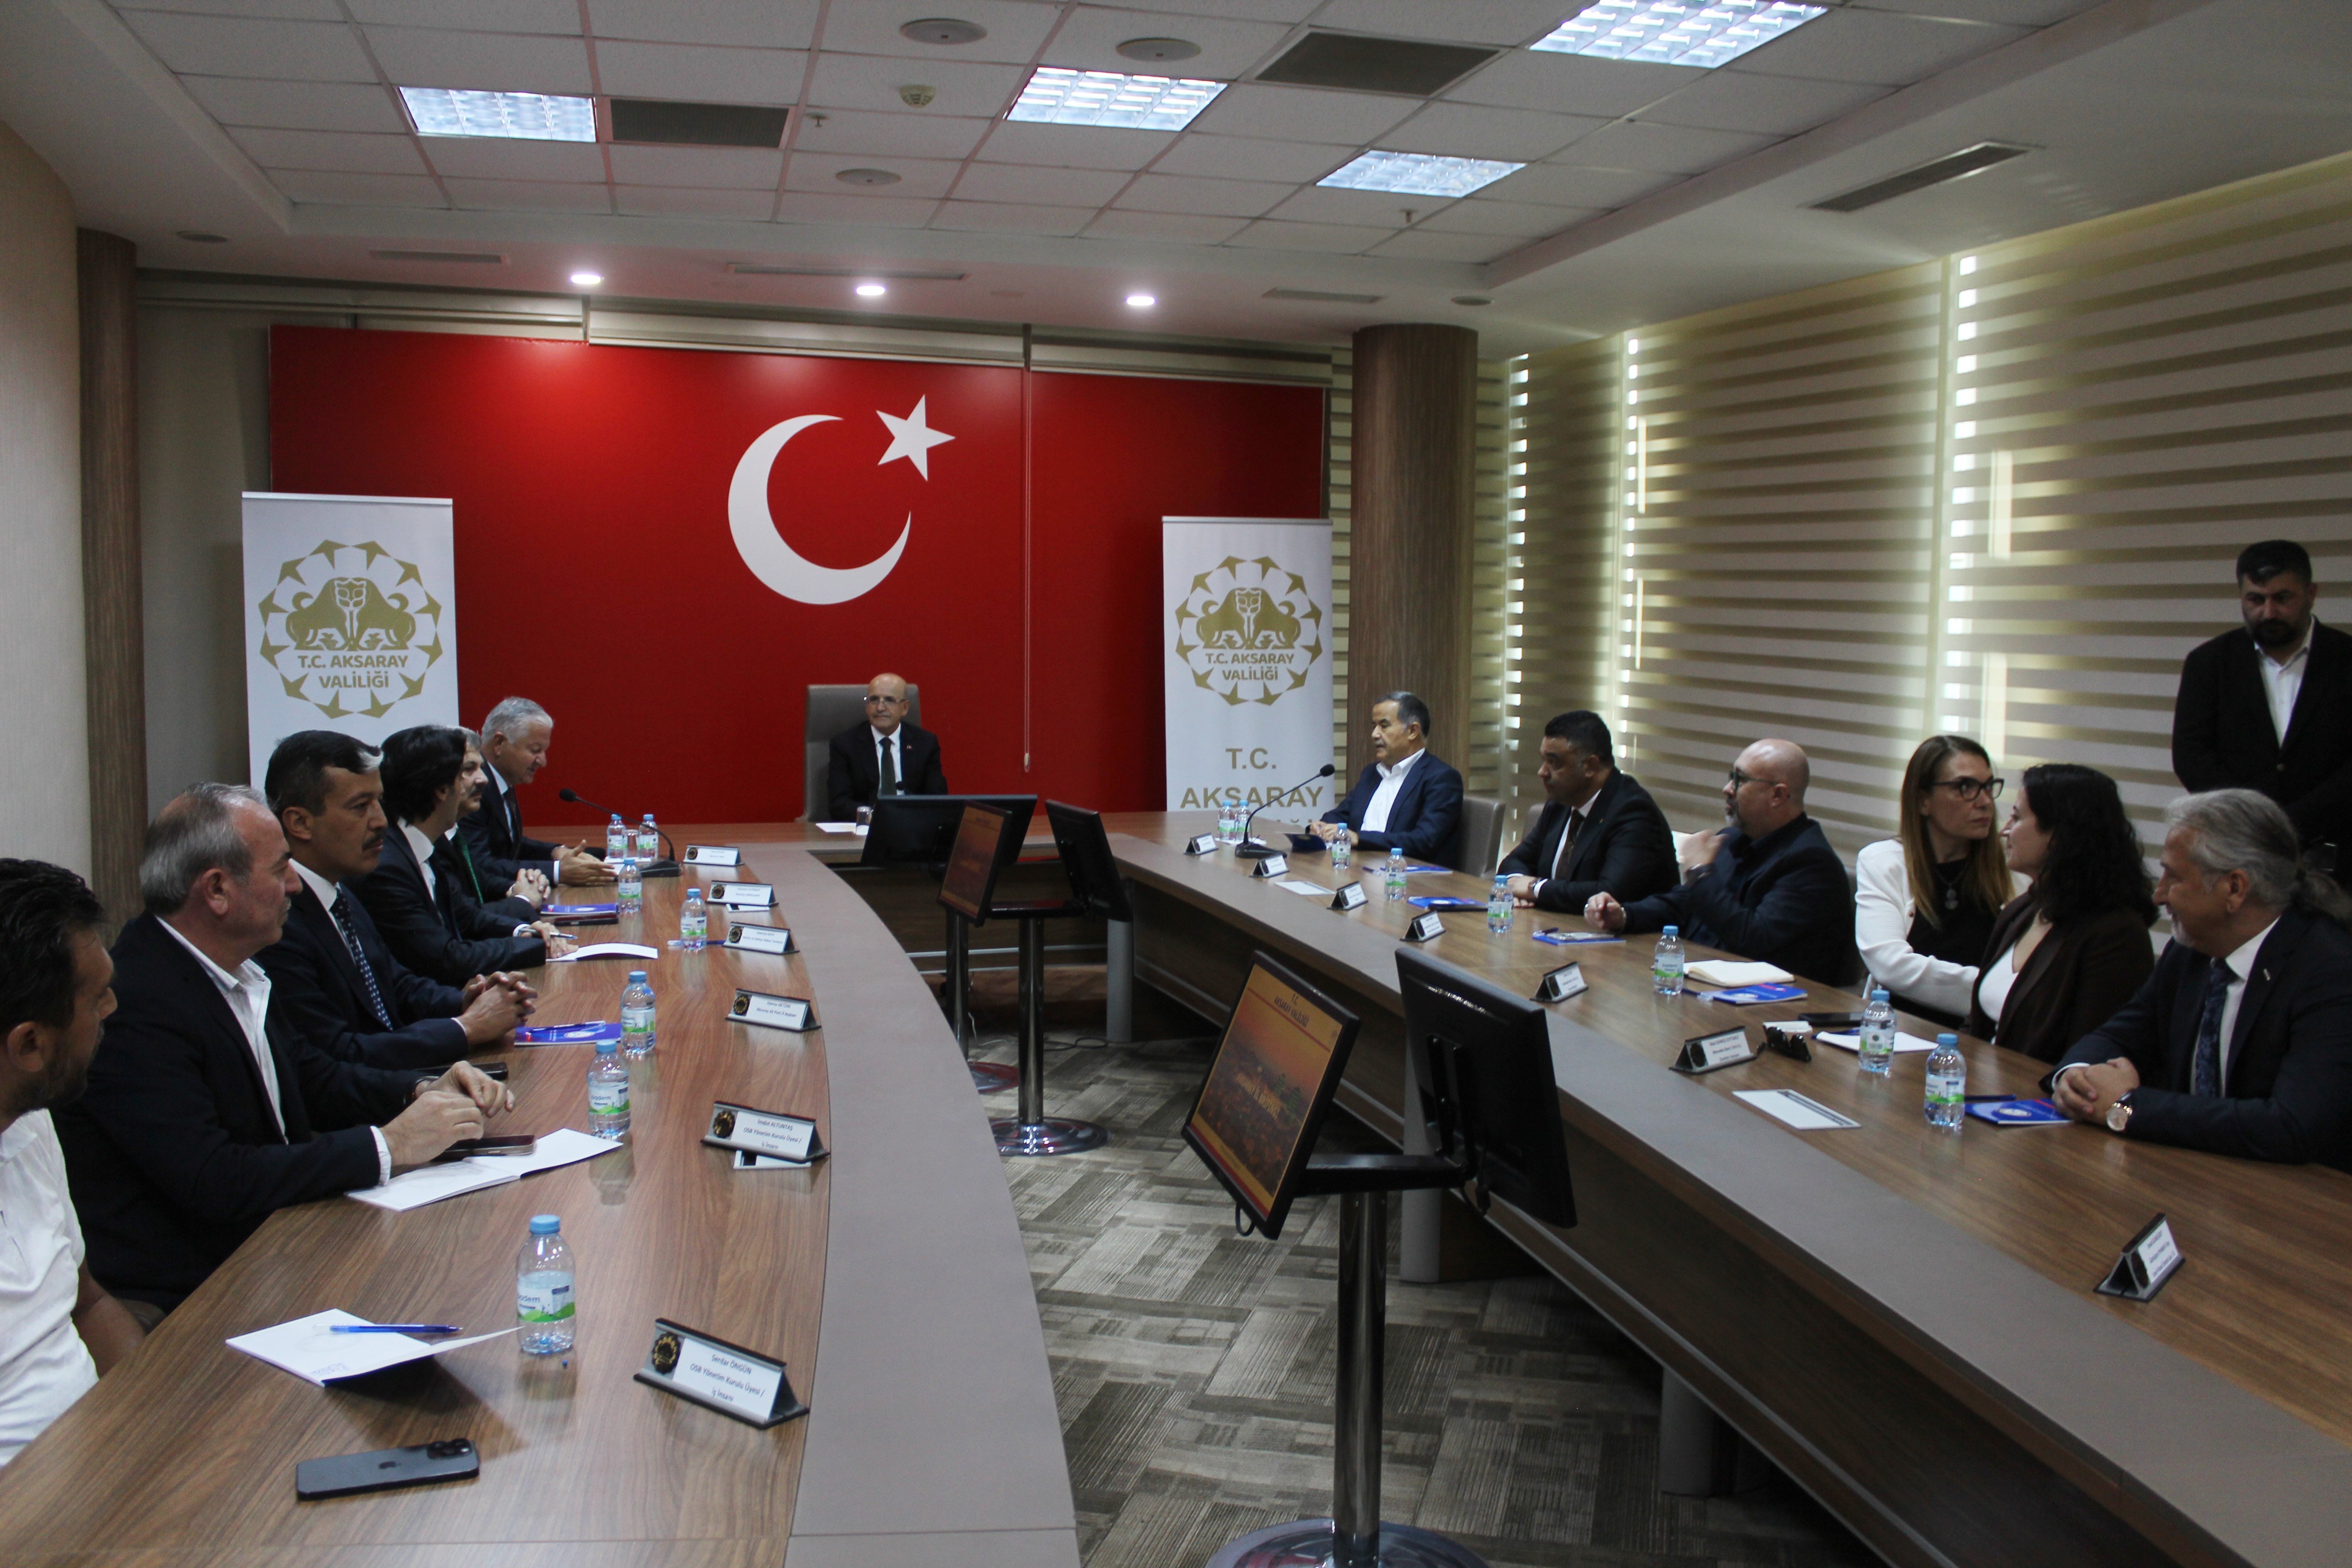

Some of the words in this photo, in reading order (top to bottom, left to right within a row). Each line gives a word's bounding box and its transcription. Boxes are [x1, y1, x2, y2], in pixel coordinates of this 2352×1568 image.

[298, 655, 326, 668] T.C.
[330, 655, 408, 668] AKSARAY
[1205, 653, 1228, 664] T.C.
[1231, 653, 1294, 664] AKSARAY
[319, 671, 389, 689] VALİLİĞİ
[1222, 665, 1279, 681] VALİLİĞİ
[1225, 748, 1276, 769] T.C.
[1180, 786, 1323, 808] AKSARAY
[1274, 996, 1291, 1013] AKSARAY
[1290, 1007, 1310, 1027] VALİLİĞİ
[711, 1354, 729, 1366] Serdar
[730, 1360, 752, 1375] ÖNGÜN
[690, 1363, 702, 1373] OSB
[703, 1368, 725, 1382] Yönetim
[725, 1376, 744, 1388] Kurulu
[745, 1382, 760, 1394] Üyesi
[717, 1389, 734, 1402] İnsanı
